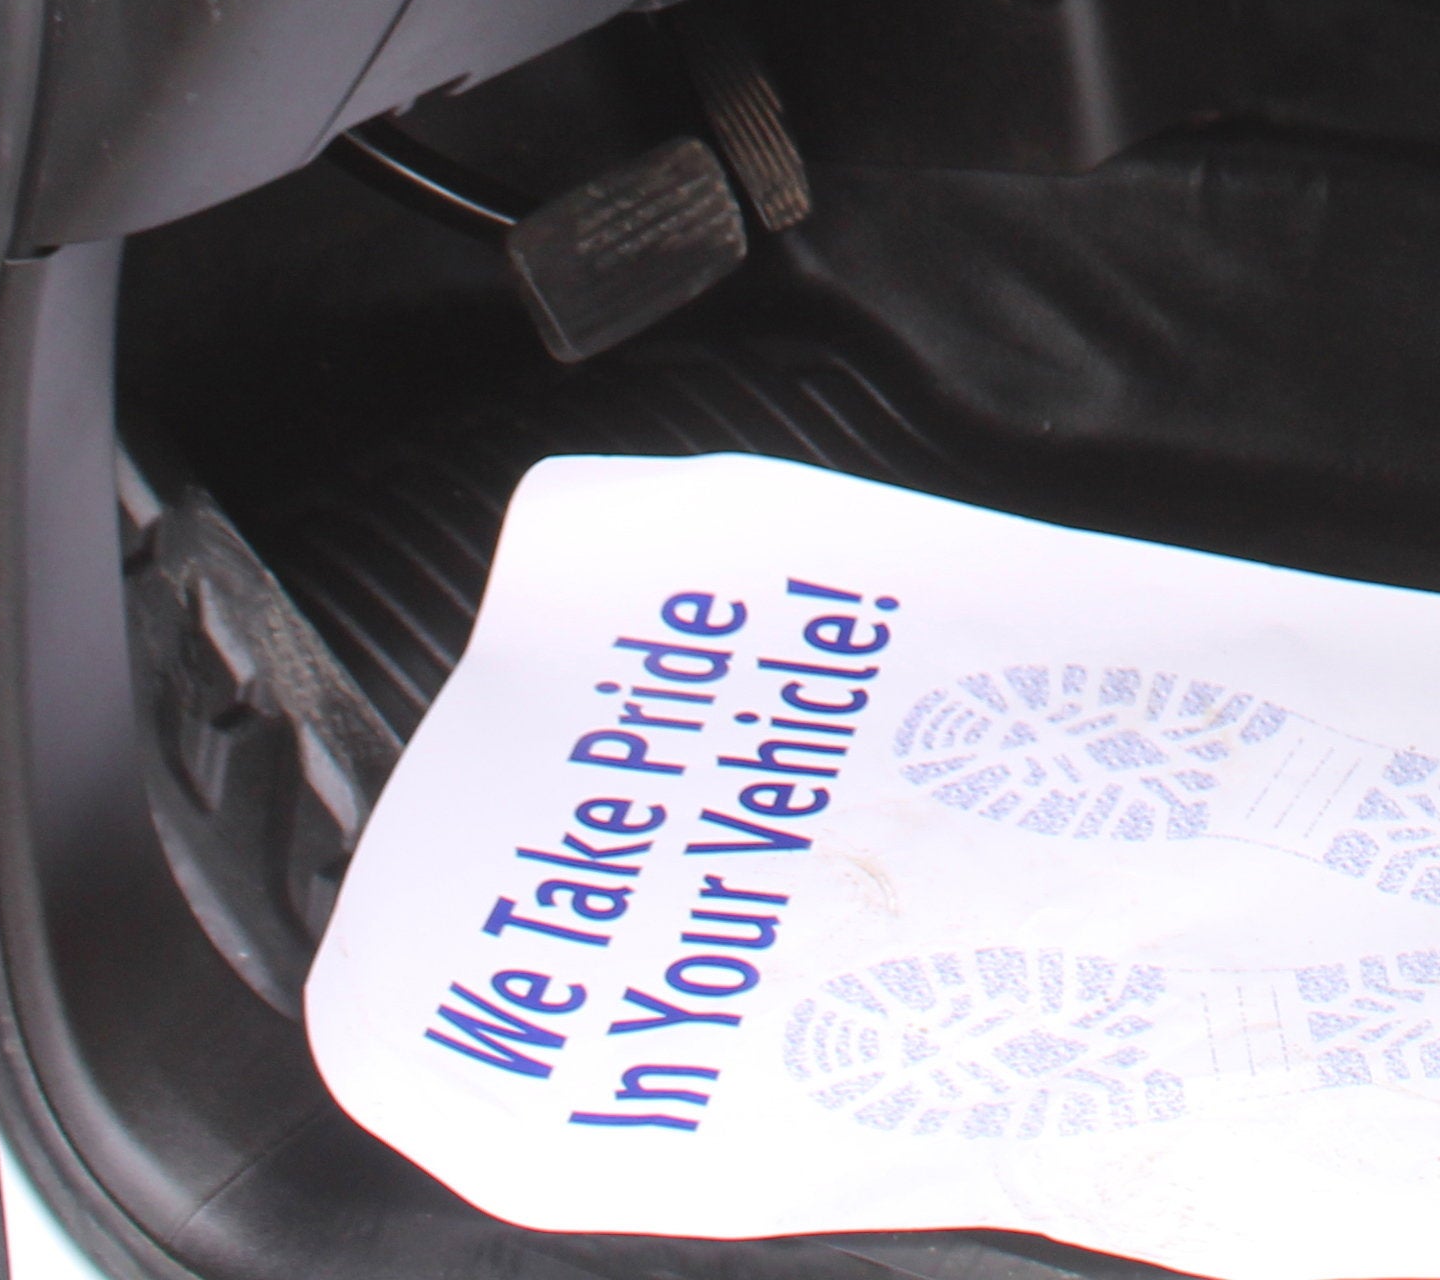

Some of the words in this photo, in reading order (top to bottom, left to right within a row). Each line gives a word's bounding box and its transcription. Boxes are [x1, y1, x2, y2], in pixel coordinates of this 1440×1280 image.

[567, 591, 748, 776] Pride
[682, 577, 900, 855] Vehicle!
[481, 797, 668, 947] Take
[423, 968, 588, 1080] We
[606, 874, 790, 1036] Your
[568, 1063, 721, 1132] In
